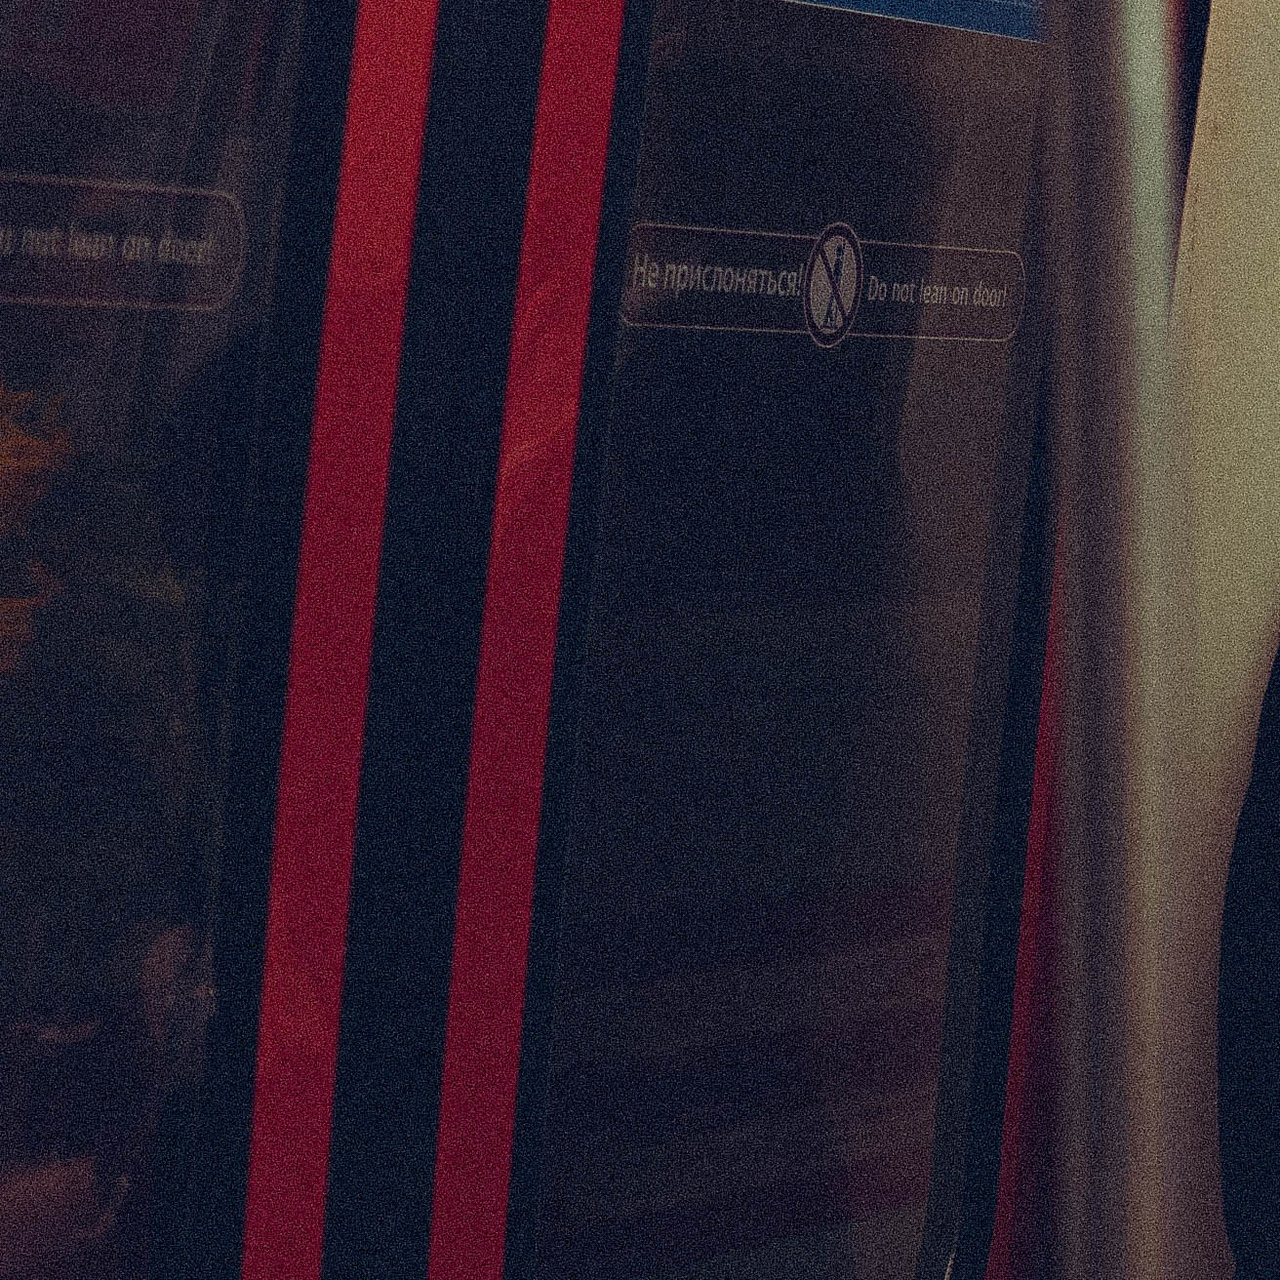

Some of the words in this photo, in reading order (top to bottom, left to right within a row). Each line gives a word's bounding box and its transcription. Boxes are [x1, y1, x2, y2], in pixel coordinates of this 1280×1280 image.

[630, 252, 659, 289] Не
[662, 261, 804, 299] прислоняться!
[867, 275, 888, 303] Do
[890, 281, 916, 305] not
[919, 277, 949, 306] lean
[950, 285, 970, 307] on
